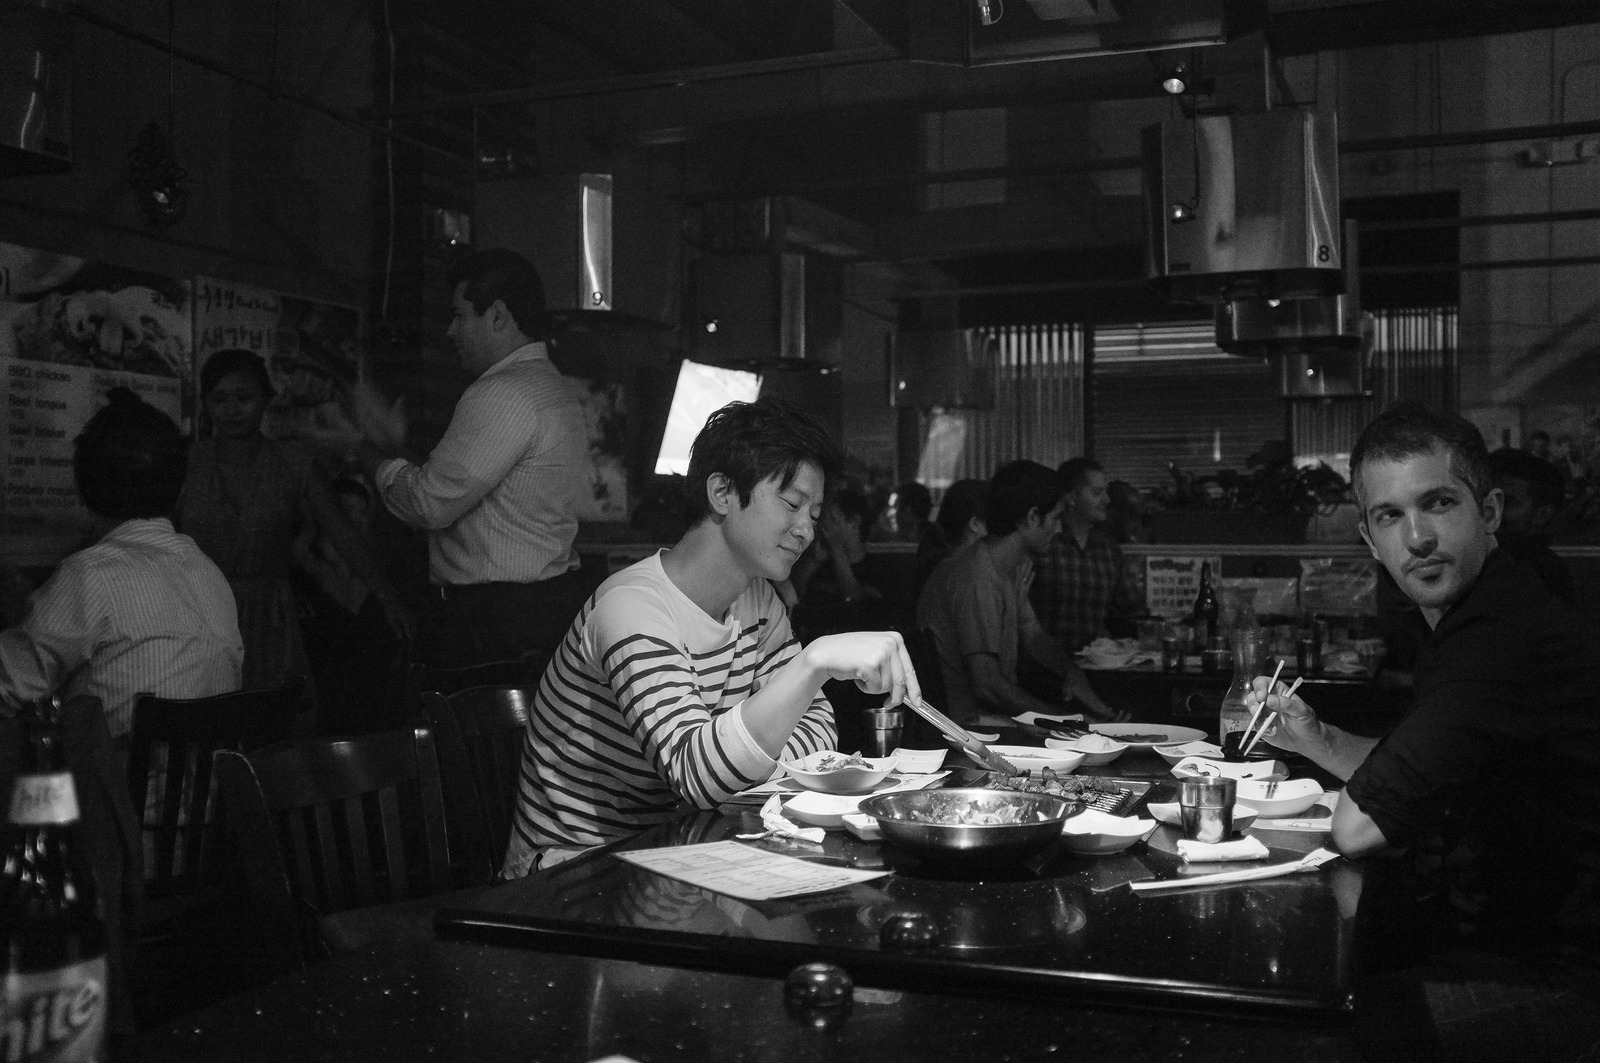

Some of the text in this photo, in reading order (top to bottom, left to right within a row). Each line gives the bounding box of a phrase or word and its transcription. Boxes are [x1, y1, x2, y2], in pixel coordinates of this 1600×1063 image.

[1319, 244, 1330, 263] 8
[592, 291, 603, 306] 9
[8, 364, 71, 382] BBQ chicken
[8, 394, 67, 411] Beef tongue
[8, 424, 31, 437] Beef
[8, 454, 35, 467] Large
